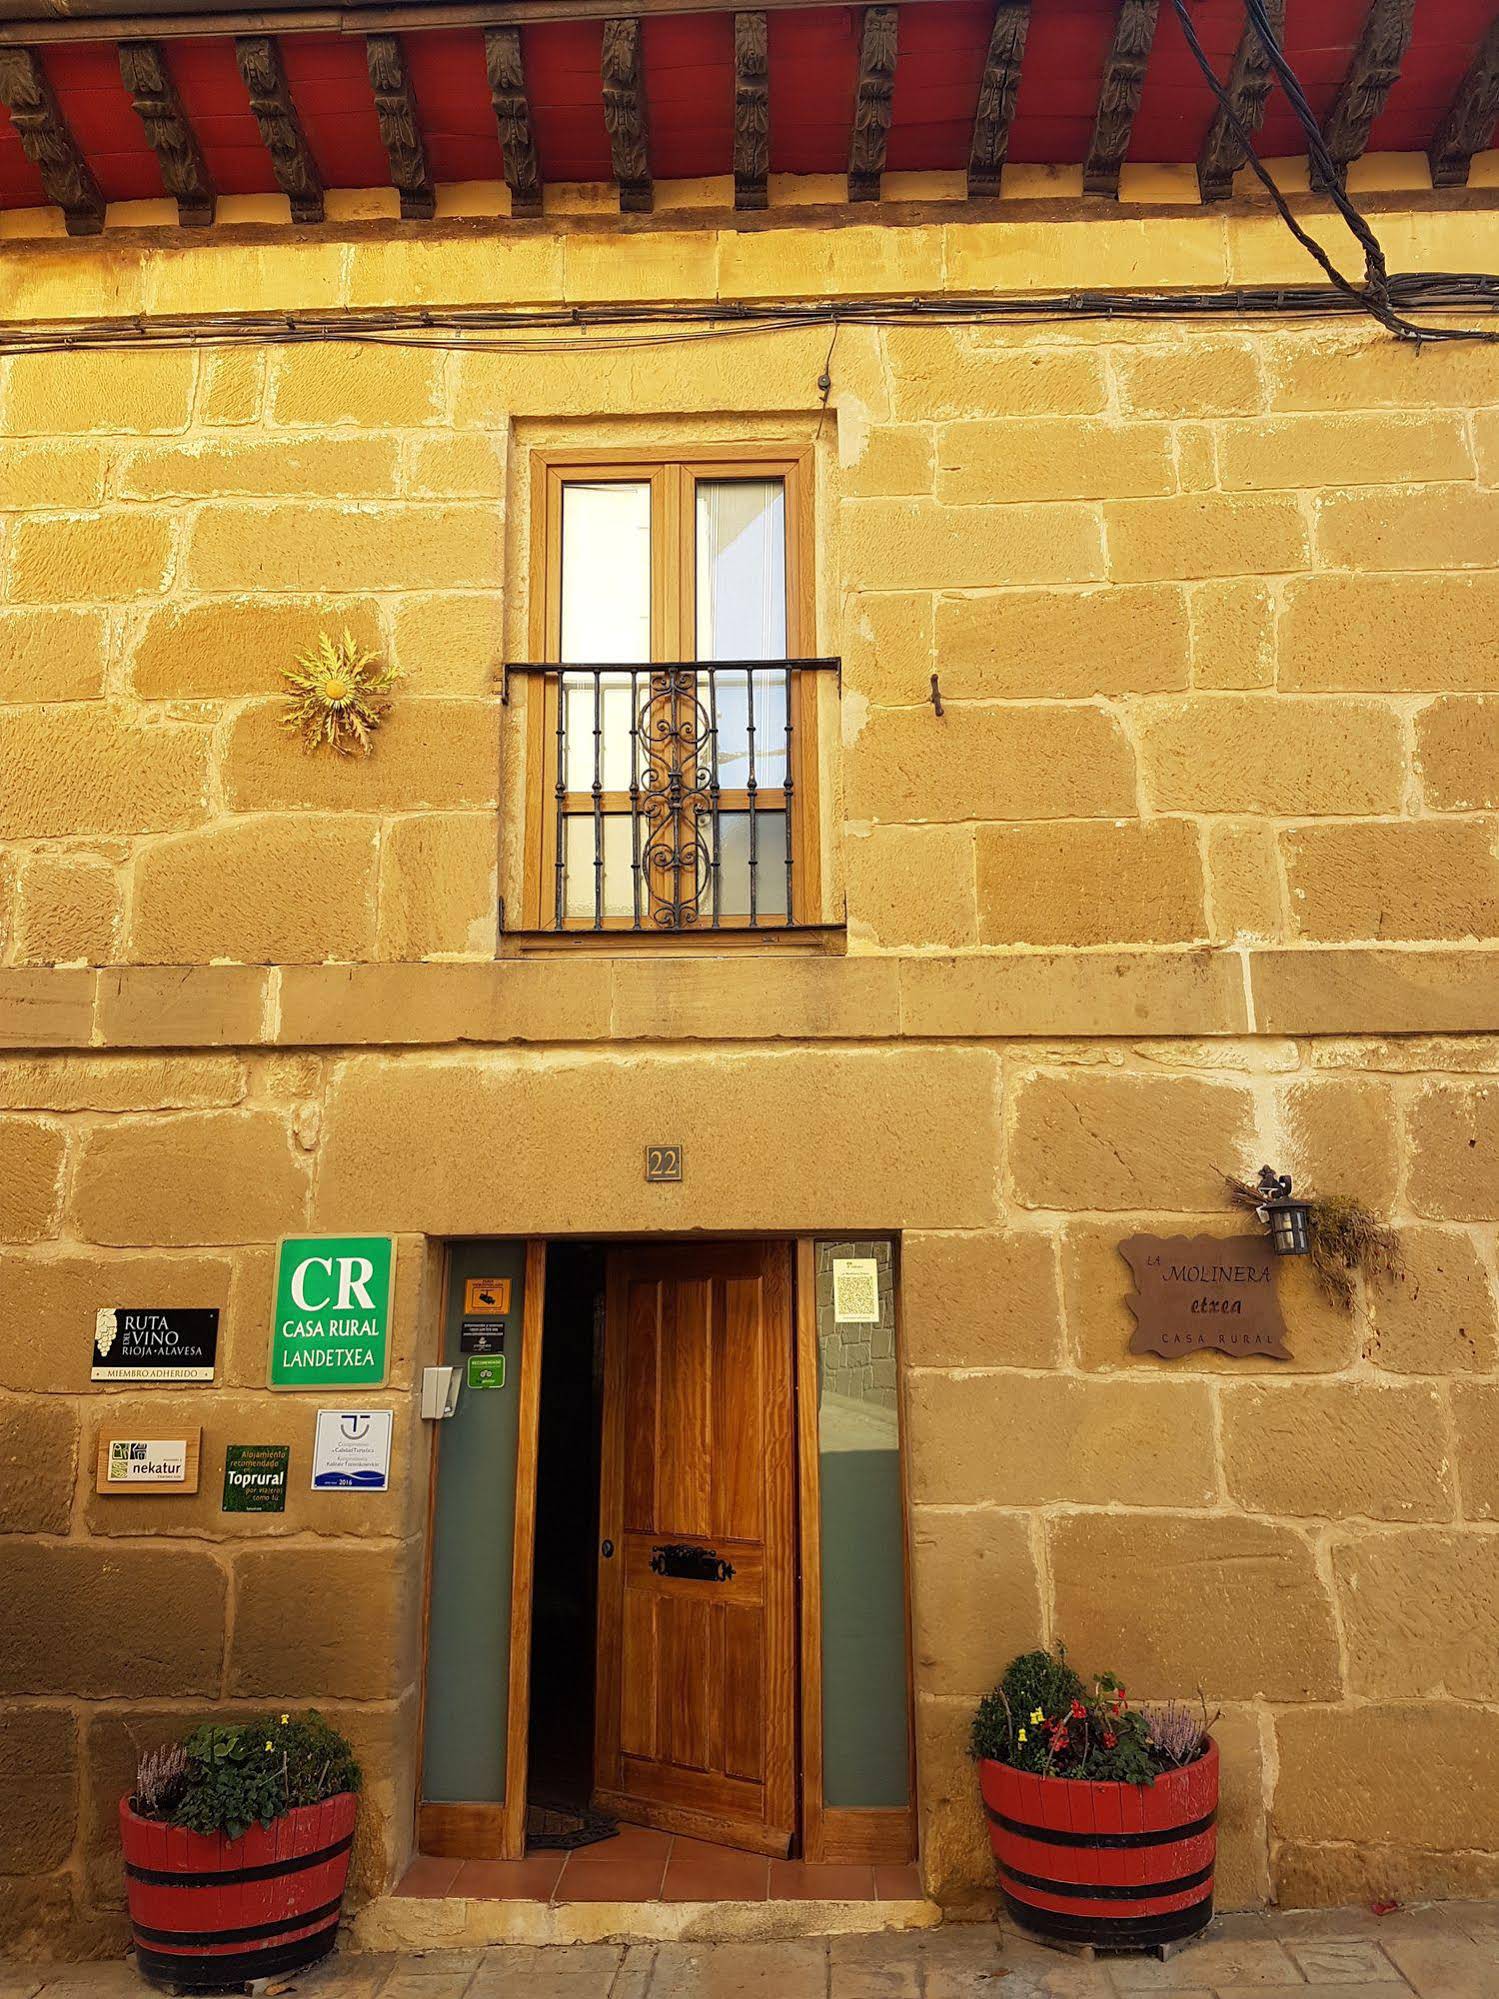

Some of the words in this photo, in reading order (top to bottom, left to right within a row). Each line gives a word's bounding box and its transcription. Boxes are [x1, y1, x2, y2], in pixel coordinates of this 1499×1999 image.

[650, 1150, 677, 1175] 22
[1147, 1255, 1161, 1266] LA
[1162, 1265, 1272, 1283] MOLINERA
[291, 1257, 376, 1312] CR
[1191, 1297, 1242, 1314] etxea
[125, 1315, 169, 1330] RUTA
[282, 1320, 325, 1338] CASA
[329, 1318, 380, 1337] RURAL
[122, 1331, 131, 1346] DEL
[132, 1330, 179, 1346] VINO
[1161, 1333, 1205, 1344] CASA
[1218, 1334, 1273, 1344] RURAL
[283, 1348, 375, 1368] LANDETXEA
[107, 1369, 149, 1378] MIEMBRO
[151, 1369, 198, 1378] ADHERIDO
[241, 1450, 286, 1460] Alojamiento
[133, 1461, 181, 1474] nekatur
[228, 1470, 284, 1489] Toprural
